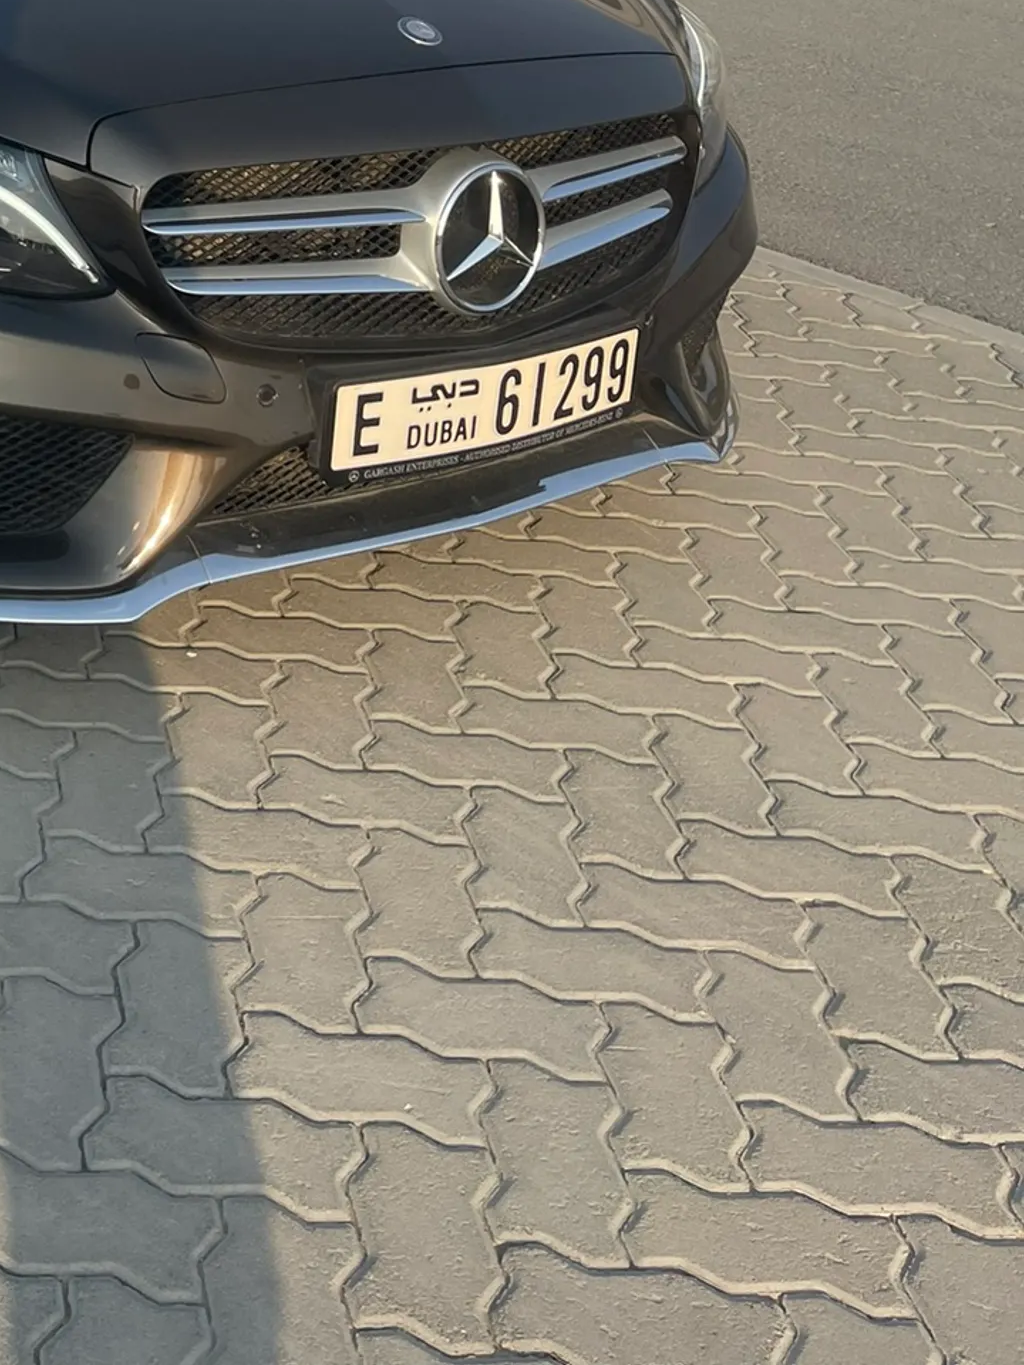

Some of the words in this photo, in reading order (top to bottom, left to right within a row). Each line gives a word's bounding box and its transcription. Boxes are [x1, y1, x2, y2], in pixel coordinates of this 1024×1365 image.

[411, 379, 480, 413] دبي
[495, 338, 630, 436] 61299
[352, 392, 384, 457] E
[406, 415, 477, 450] DUBAI
